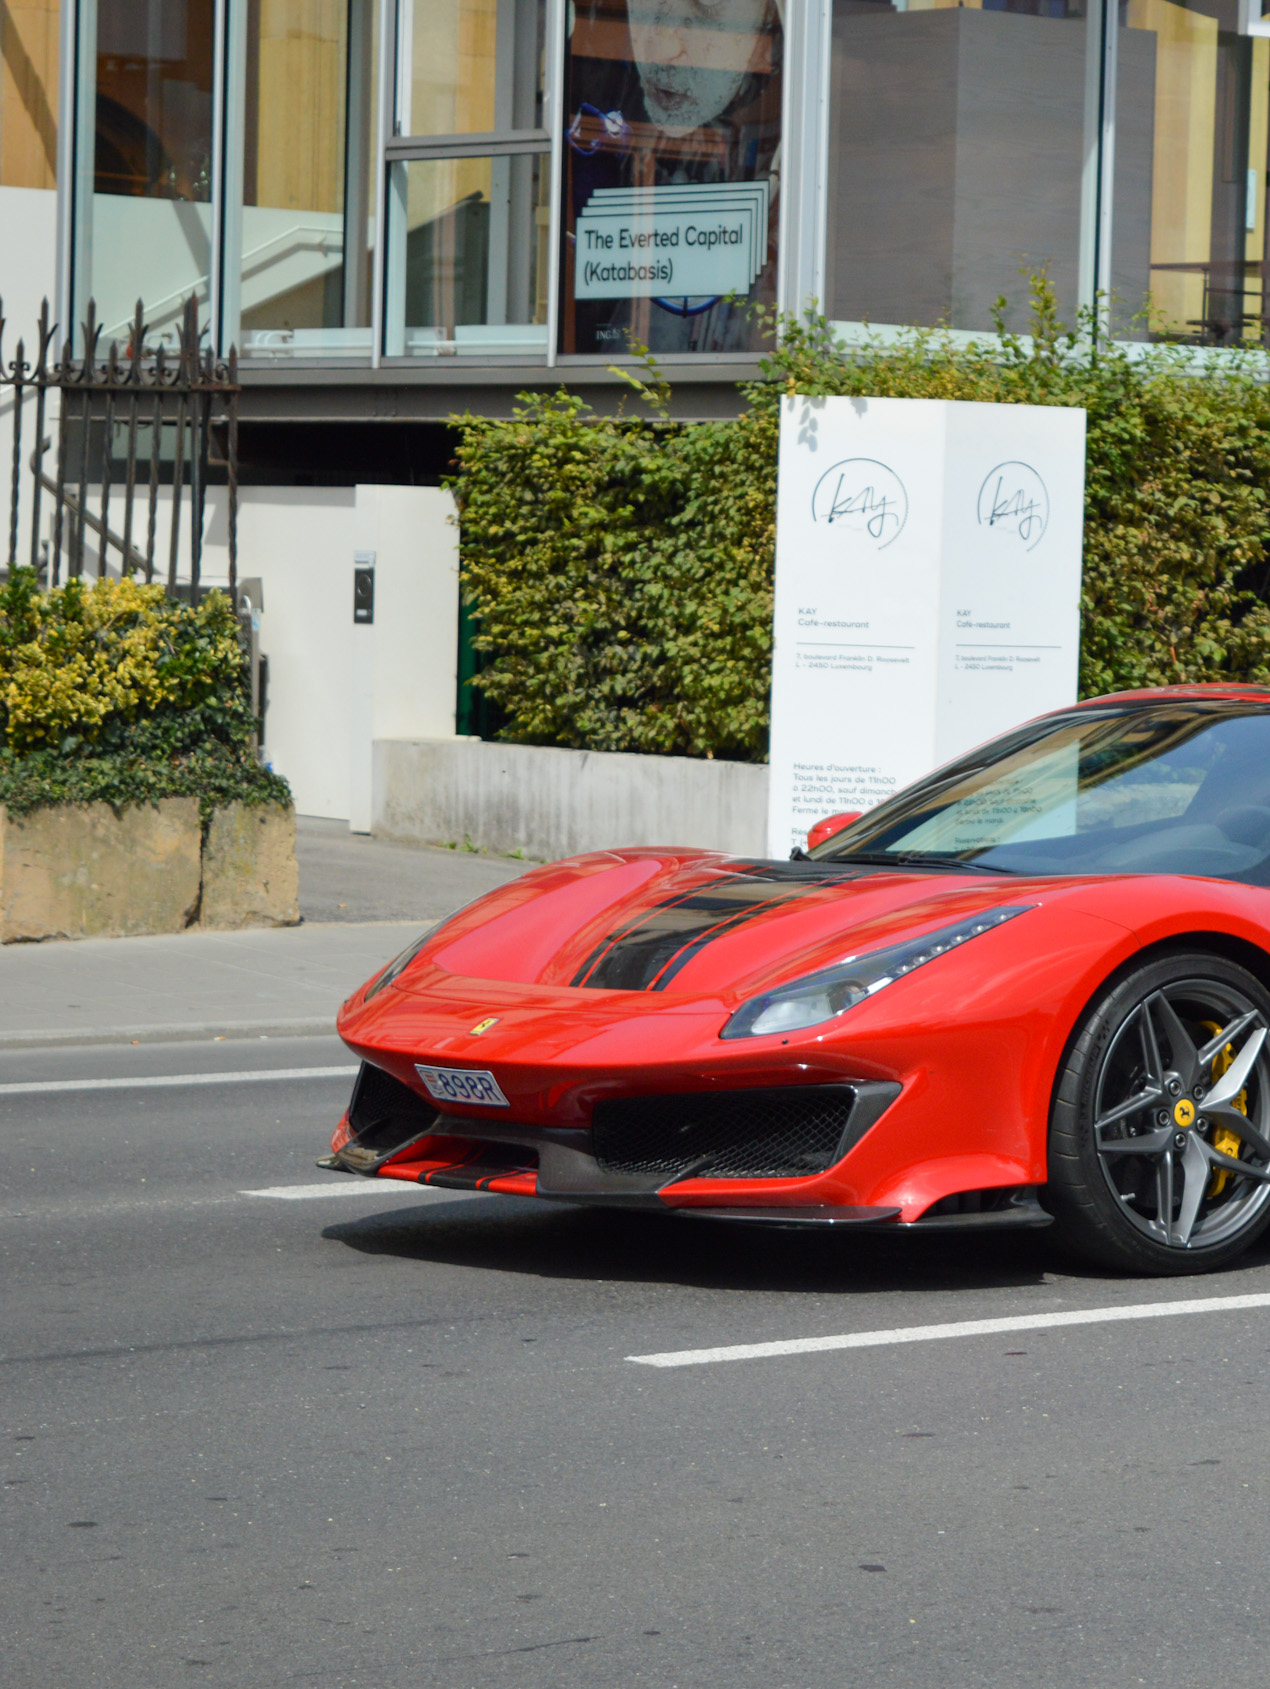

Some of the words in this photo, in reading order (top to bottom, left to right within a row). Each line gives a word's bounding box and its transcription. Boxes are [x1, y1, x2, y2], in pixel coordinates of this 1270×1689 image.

[584, 229, 614, 249] The
[619, 226, 680, 248] Everted
[685, 223, 743, 251] Capital
[584, 257, 673, 287] (Katabasis)
[956, 609, 972, 617] KAY
[838, 654, 866, 662] Franklin
[830, 663, 873, 671] Luxembourg
[793, 763, 824, 771] Heures
[827, 764, 876, 773] d'ouverture
[793, 773, 813, 782] Tous
[816, 774, 828, 782] les
[830, 775, 852, 784] jours
[855, 776, 866, 784] de
[838, 786, 857, 794] sauf
[860, 787, 897, 796] dimanch
[825, 796, 836, 804] de
[821, 806, 828, 814] le
[438, 1073, 501, 1101] 898R
